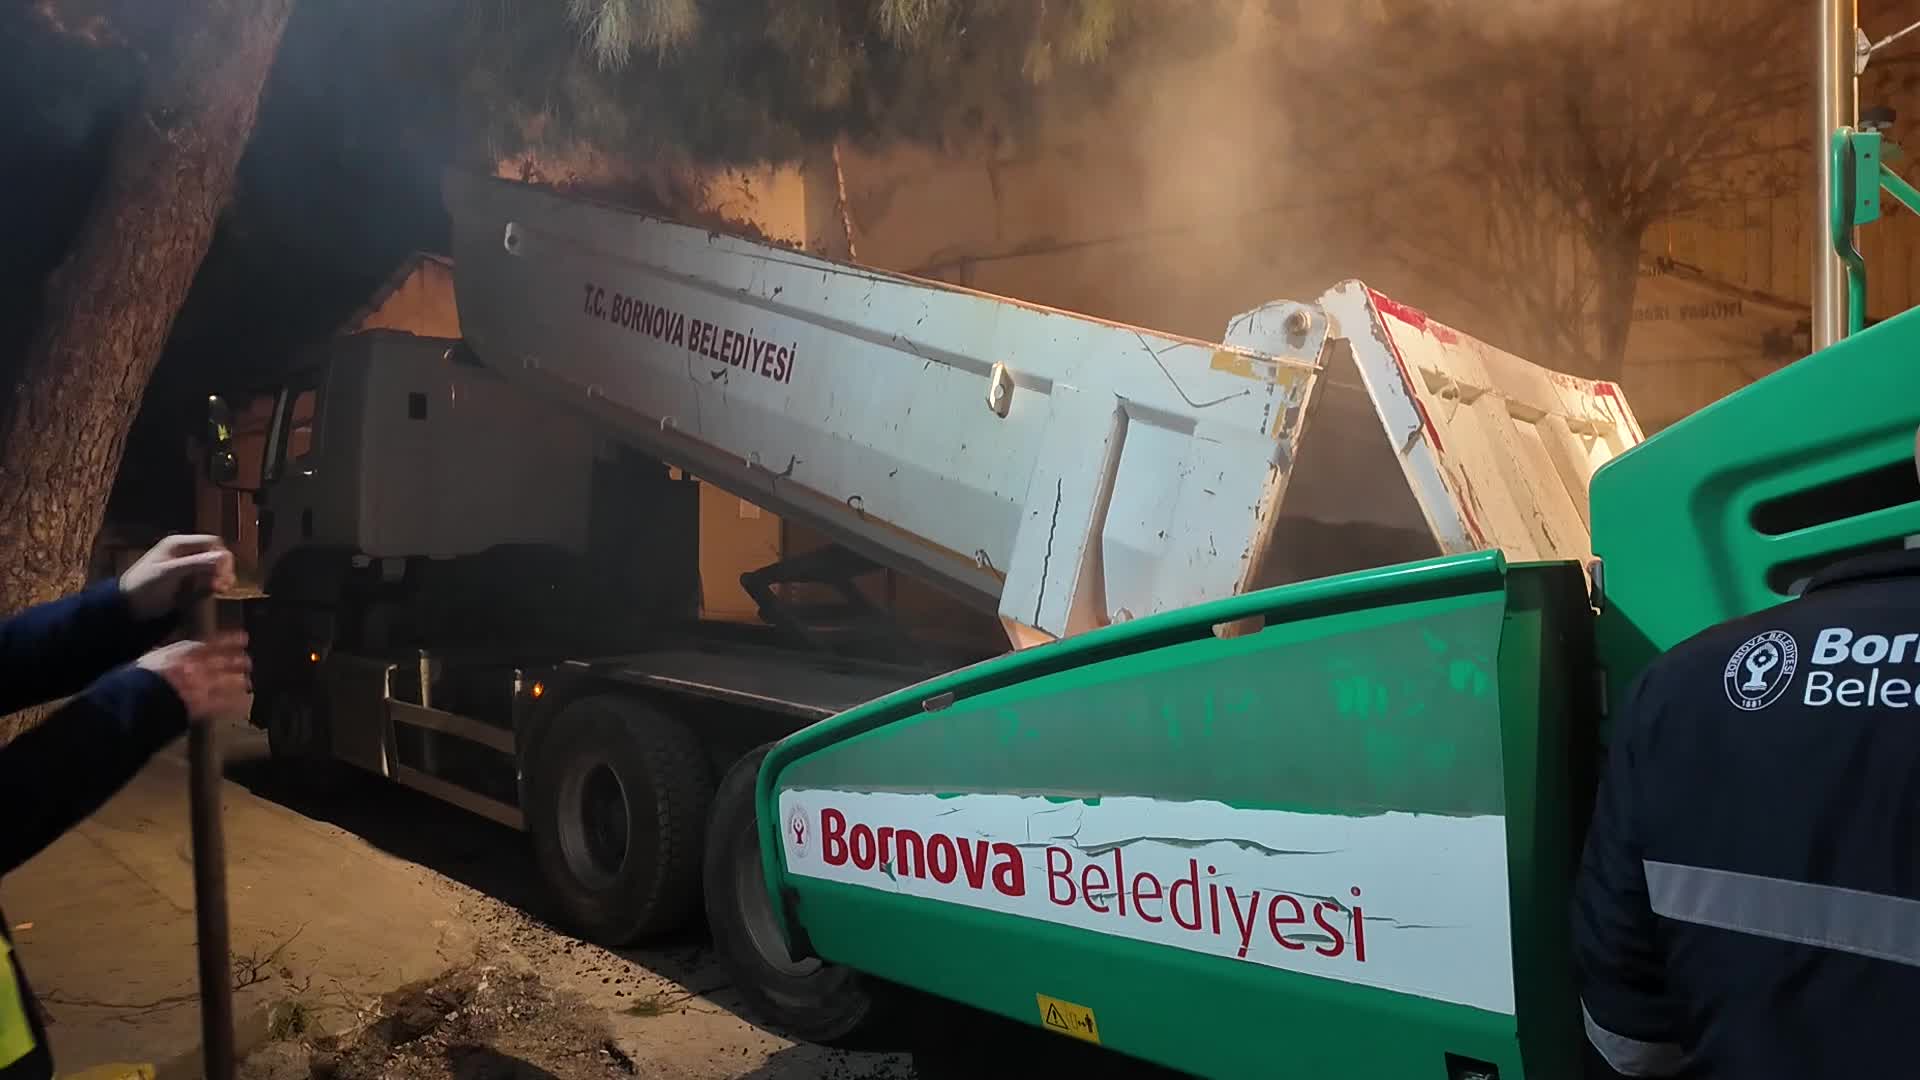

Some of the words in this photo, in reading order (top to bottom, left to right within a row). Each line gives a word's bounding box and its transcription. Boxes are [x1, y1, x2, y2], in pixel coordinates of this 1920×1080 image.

[584, 283, 606, 320] T.C.
[611, 293, 684, 347] BORNOVA
[687, 318, 797, 384] BELEDİYESİ
[1727, 636, 1766, 678] BORNOVA
[1811, 627, 1920, 665] Bor
[1803, 667, 1920, 708] Bele
[820, 807, 1026, 897] Bornova
[1045, 846, 1366, 962] Belediyesi
